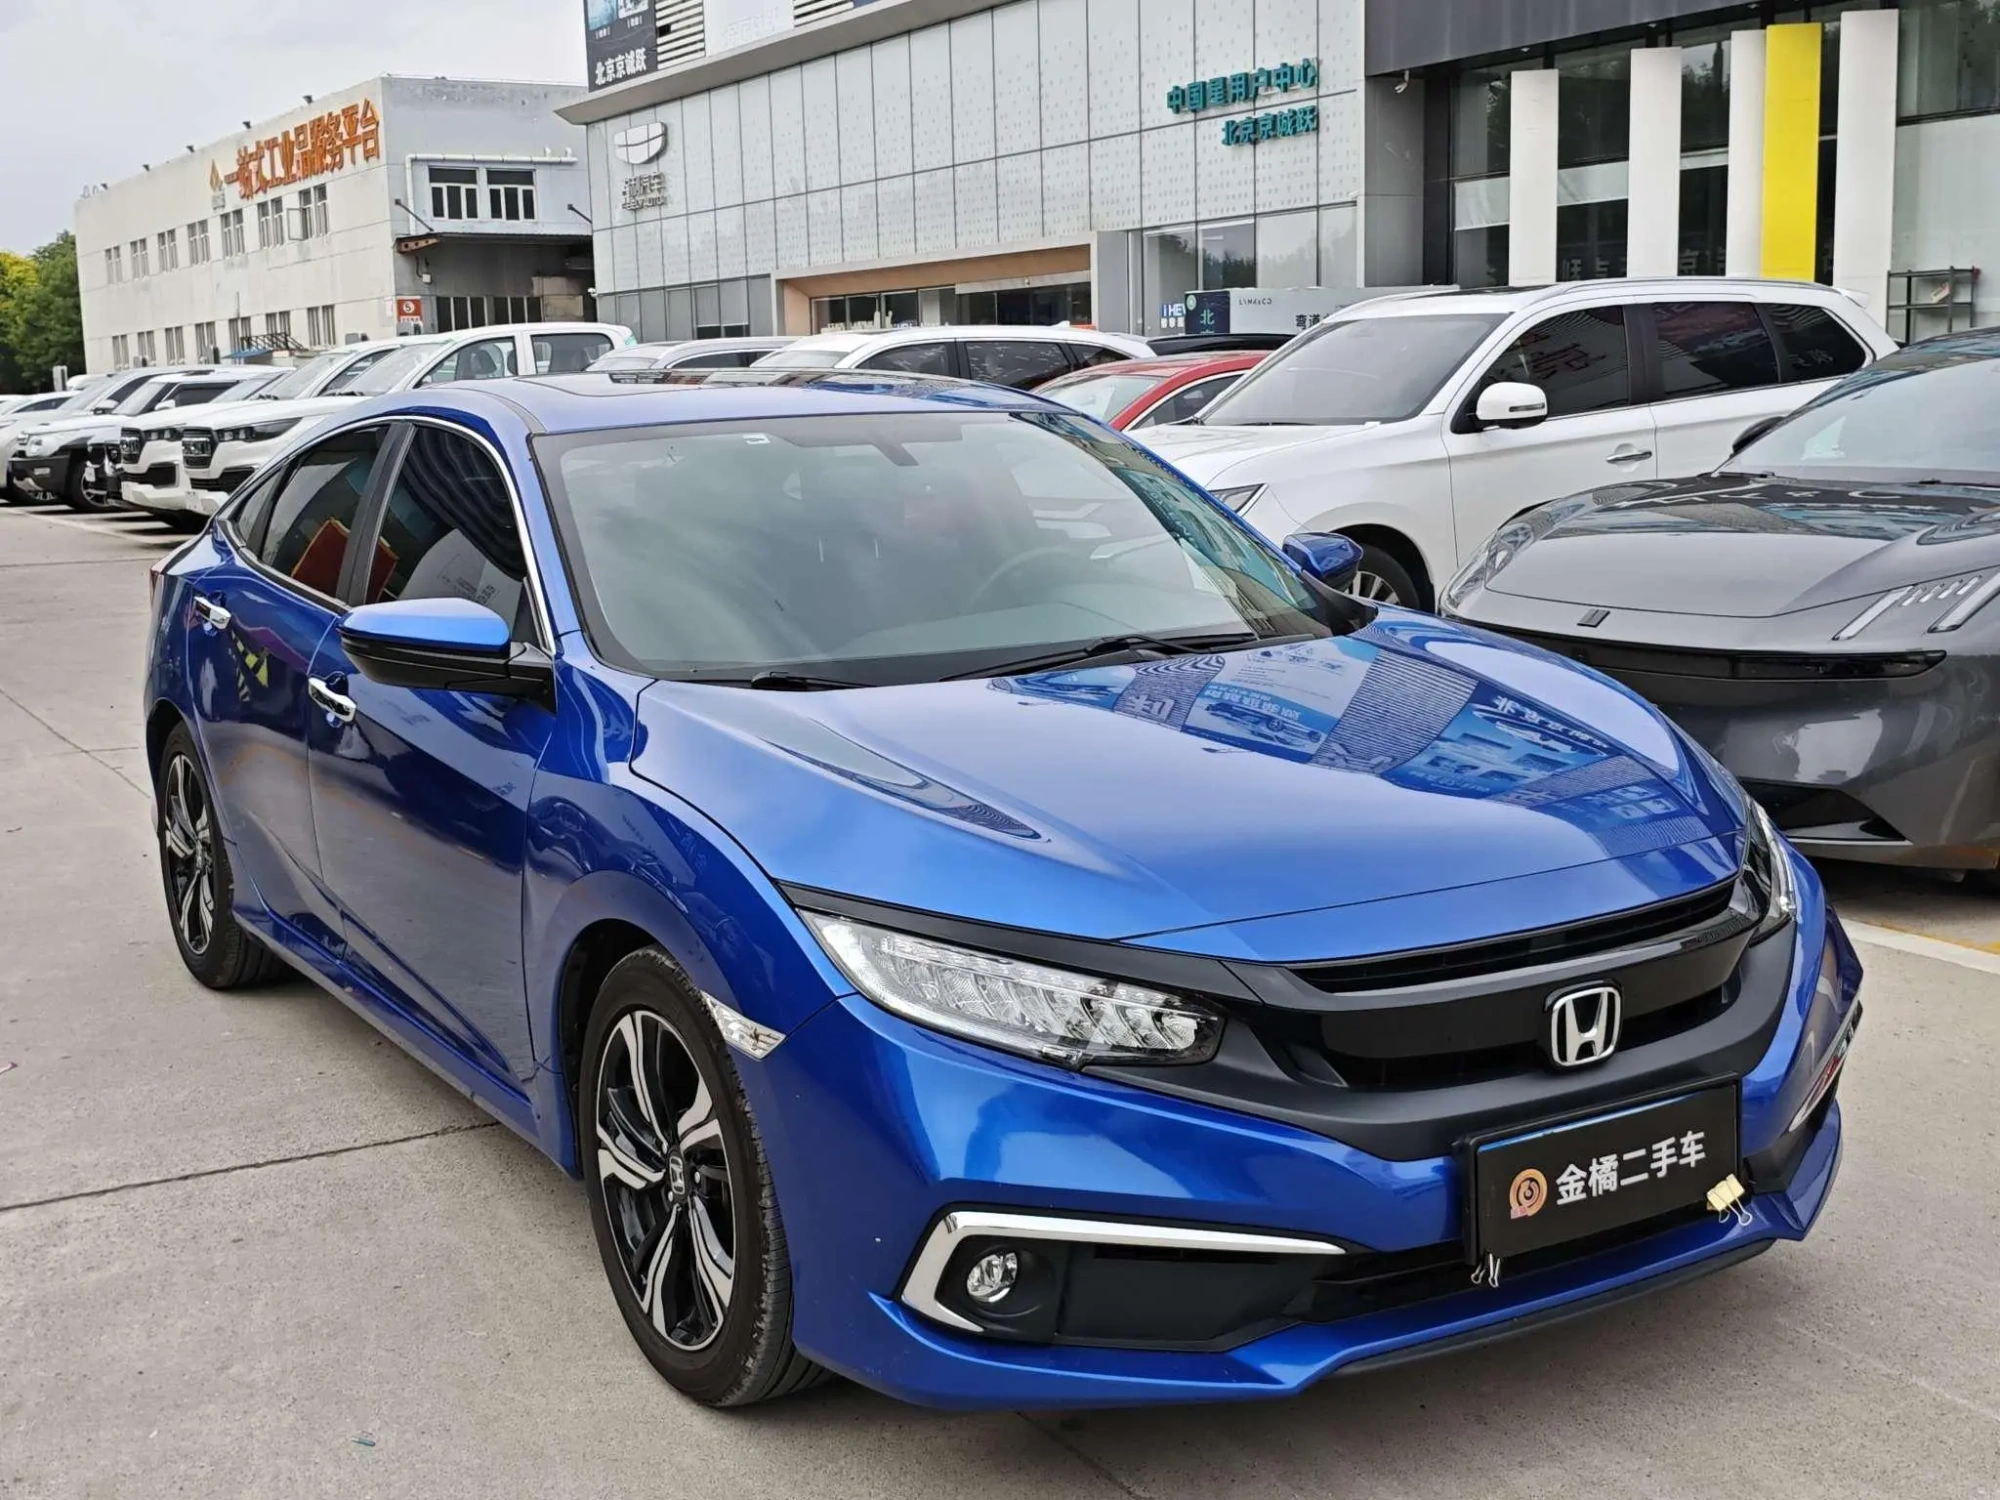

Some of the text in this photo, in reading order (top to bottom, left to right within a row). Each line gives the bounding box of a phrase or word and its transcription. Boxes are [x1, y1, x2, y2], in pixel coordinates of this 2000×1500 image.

[595, 47, 647, 86] 北京京诚跃
[1167, 58, 1317, 113] 中国星用户中心
[224, 98, 379, 200] 一站式工业品服务平台
[1200, 309, 1215, 333] 北
[1295, 313, 1331, 331] 弯道
[1555, 1130, 1706, 1205] 金橘二手车
